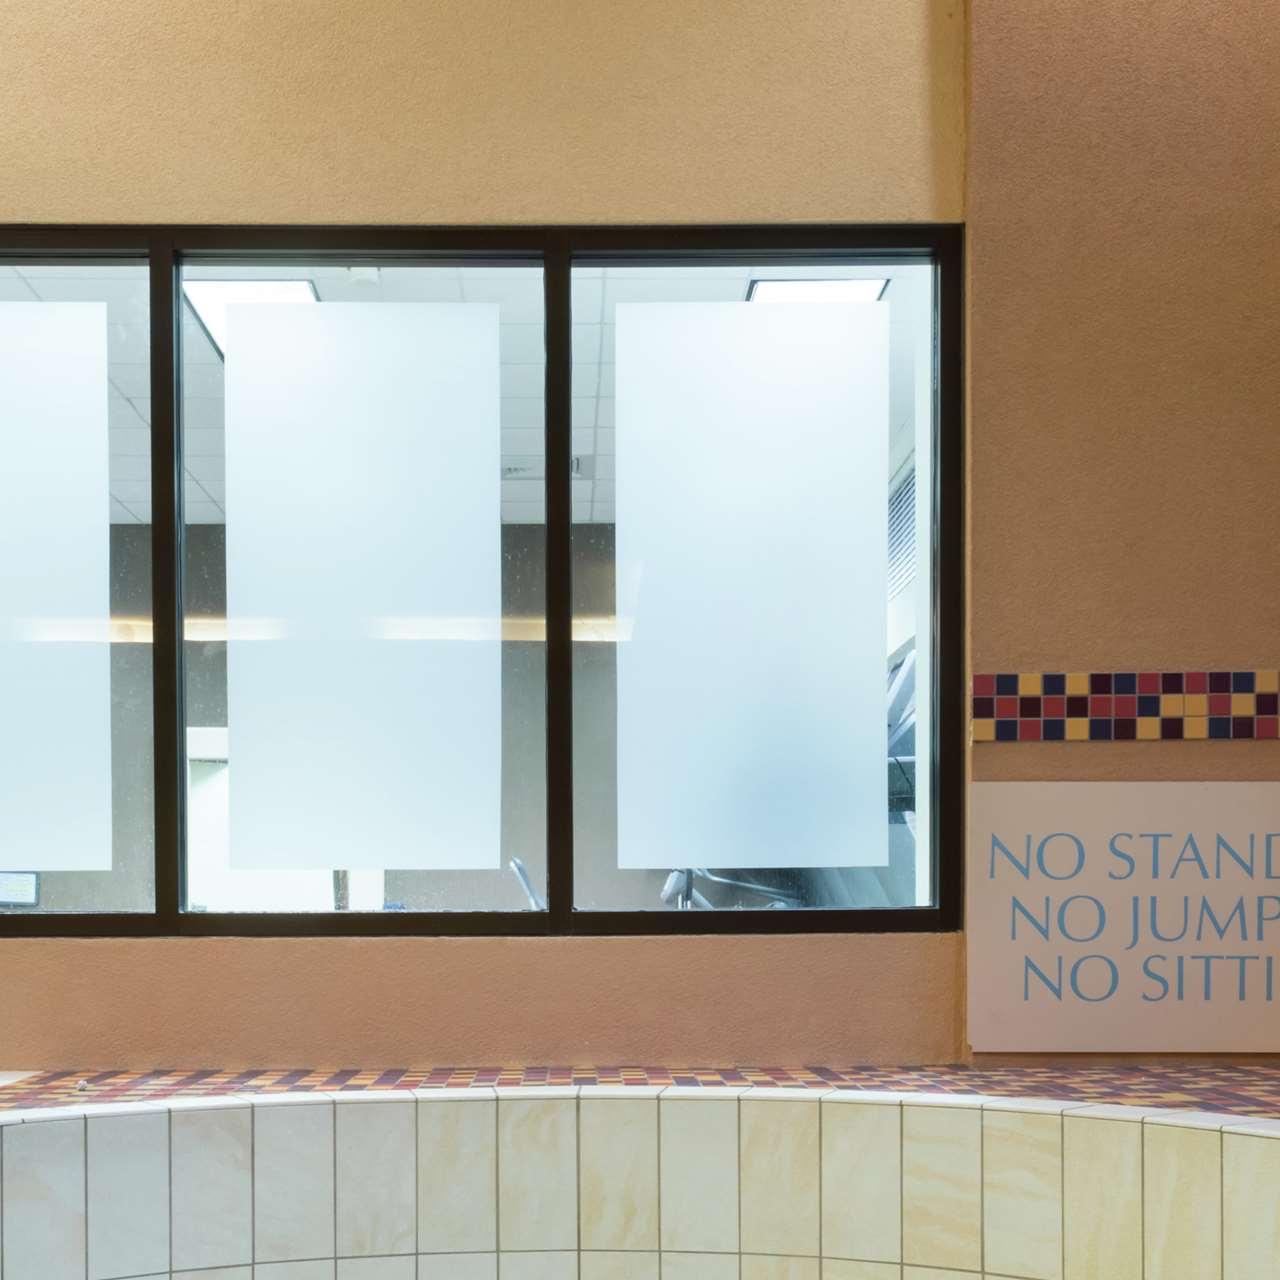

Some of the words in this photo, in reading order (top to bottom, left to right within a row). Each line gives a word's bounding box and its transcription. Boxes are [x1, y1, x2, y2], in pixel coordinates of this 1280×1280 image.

[988, 832, 1086, 881] NO
[1010, 895, 1106, 943] NO
[1023, 954, 1119, 1003] NO
